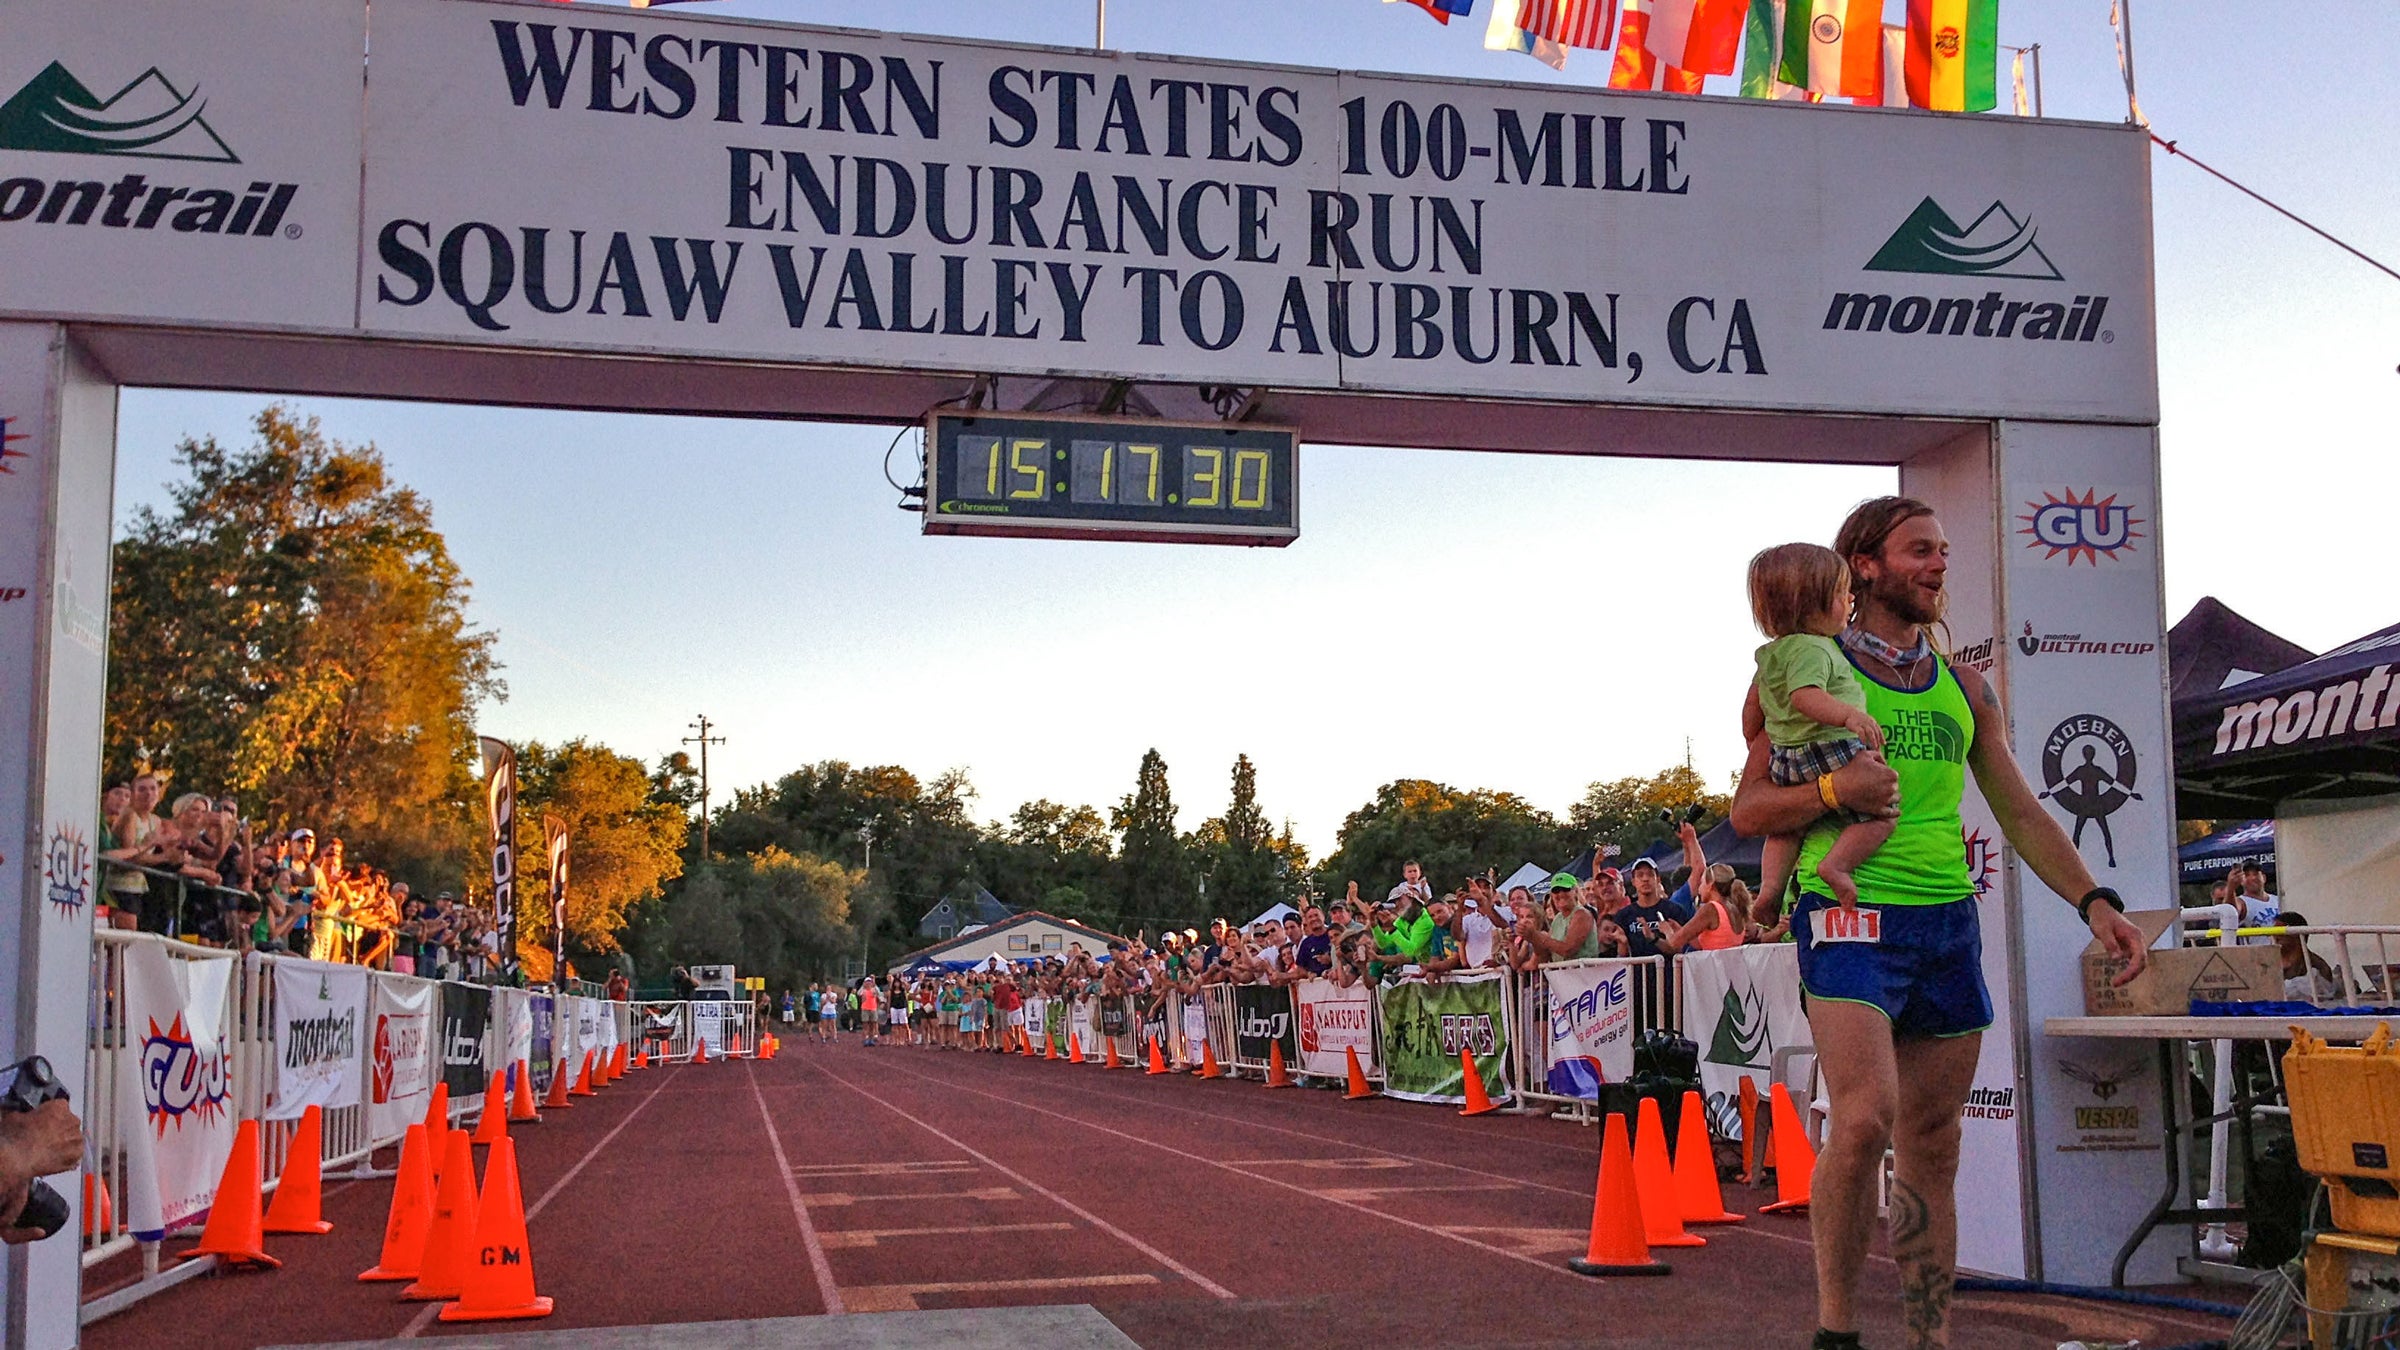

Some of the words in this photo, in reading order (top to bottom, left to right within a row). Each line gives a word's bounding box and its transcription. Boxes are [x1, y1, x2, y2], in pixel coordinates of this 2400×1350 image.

[490, 19, 944, 140] WESTERN
[988, 65, 1302, 167] STATES
[1340, 96, 1690, 195] 100-MILE
[0, 173, 298, 241] ontrail
[726, 146, 1280, 264] ENDURANCE
[1308, 188, 1484, 276] RUN
[377, 218, 743, 332] SQUAW
[766, 244, 1103, 342] VALLEY
[1124, 266, 1245, 351] TO
[1268, 276, 1643, 384] AUBURN,
[1666, 295, 1770, 376] CA
[1822, 289, 2109, 344] montrail
[2033, 503, 2129, 551] GU
[1953, 637, 1993, 664] ntrail
[2040, 641, 2106, 654] ULTRA
[2110, 643, 2155, 654] CUP
[2043, 633, 2081, 641] montrail
[1972, 659, 1993, 673] UP
[1892, 709, 1930, 726] THE
[2212, 664, 2400, 756] montr
[1881, 725, 1932, 744] ORTH
[2048, 719, 2130, 756] MOEBEN
[51, 835, 84, 891] GU
[2184, 860, 2202, 871] PURE
[1825, 908, 1879, 939] M1
[1585, 1007, 1628, 1039] endurance
[1594, 1028, 1617, 1048] energy
[1965, 1087, 2013, 1107] ntrail
[1962, 1106, 1985, 1119] TRA
[1986, 1106, 2014, 1121] CUP
[2075, 1106, 2138, 1130] VESPA
